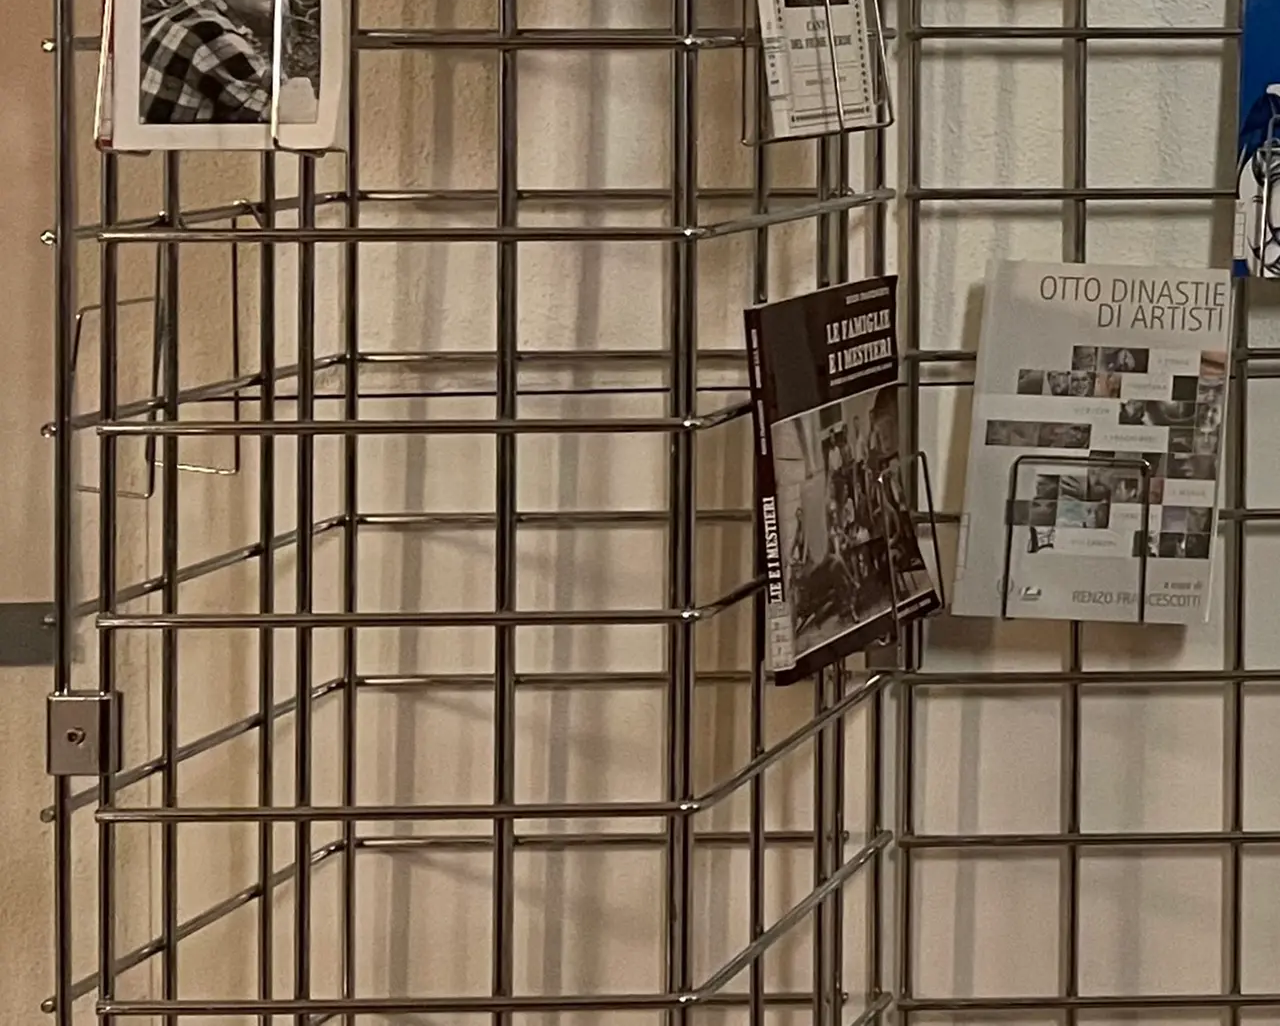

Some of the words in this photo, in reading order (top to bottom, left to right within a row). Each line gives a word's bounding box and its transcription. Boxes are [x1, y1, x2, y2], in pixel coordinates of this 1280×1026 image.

[1040, 275, 1101, 302] OTTO
[1111, 278, 1226, 307] DINASTIE
[826, 321, 840, 345] LE
[841, 308, 891, 341] FAMIGLIE
[1097, 303, 1122, 328] DI
[1130, 305, 1224, 332] ARTISTI
[828, 353, 836, 374] E
[837, 351, 843, 372] I
[843, 337, 892, 370] MESTIERI
[762, 496, 780, 560] MESTIERI
